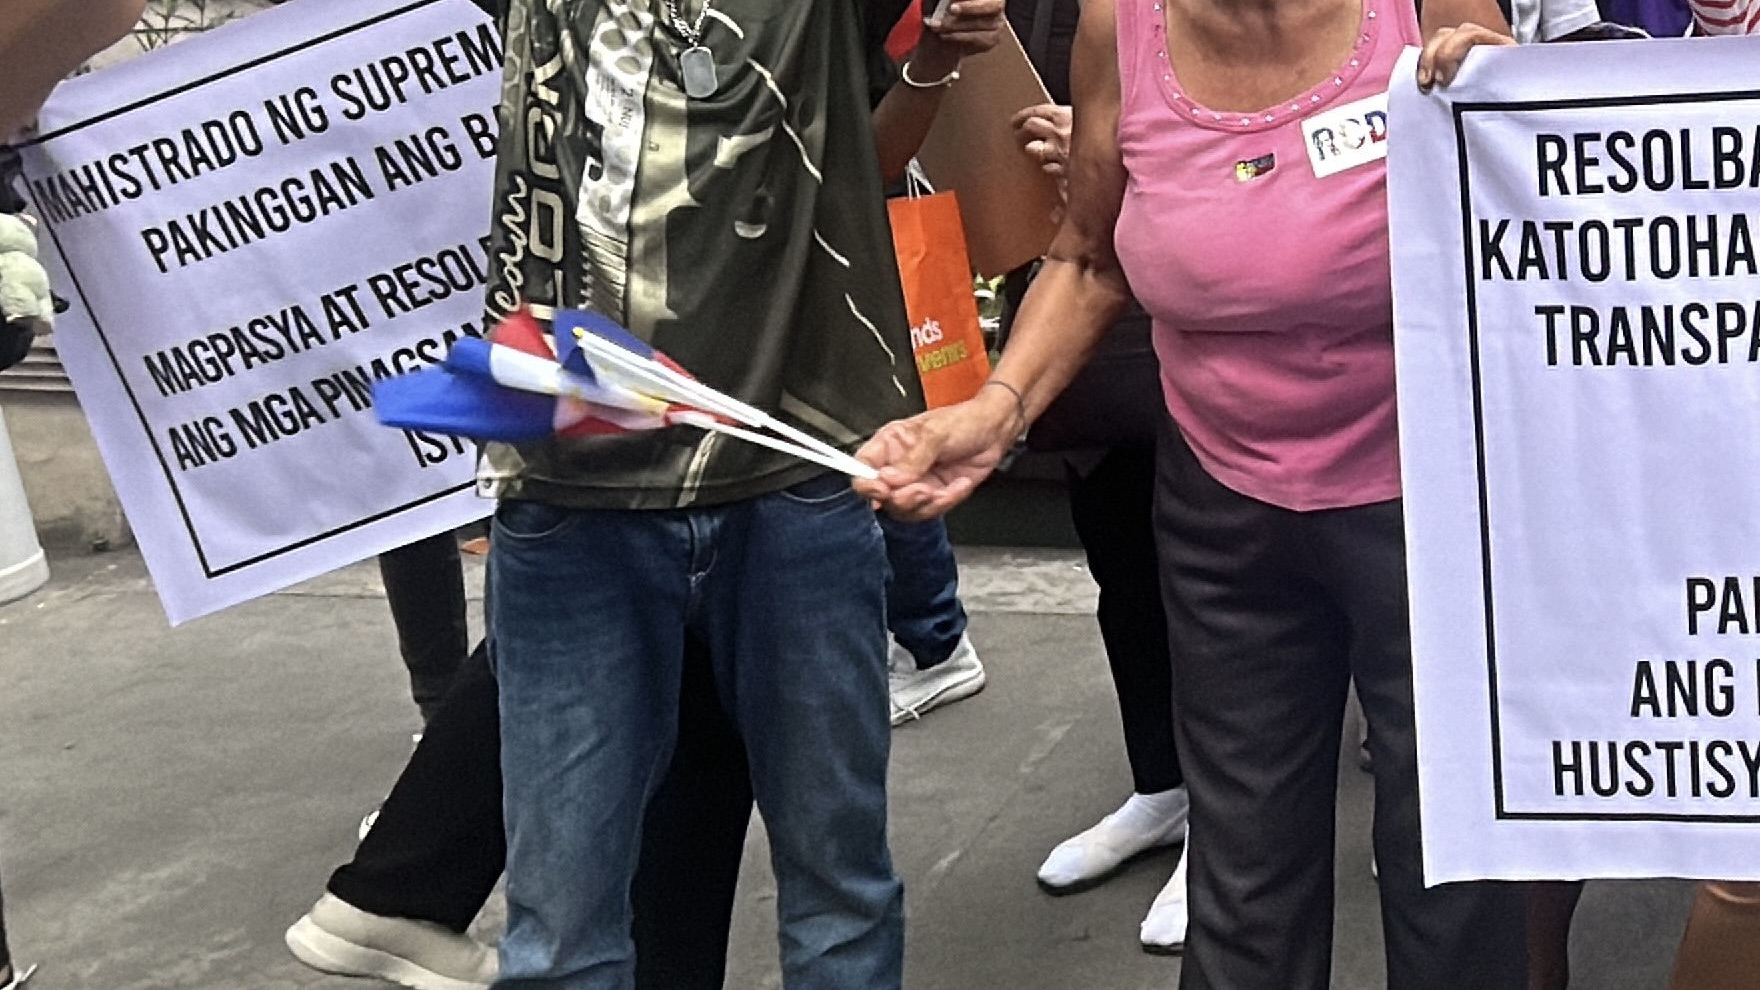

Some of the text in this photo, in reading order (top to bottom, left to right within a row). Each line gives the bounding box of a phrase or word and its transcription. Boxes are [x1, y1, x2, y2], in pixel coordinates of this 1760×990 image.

[34, 110, 265, 224] MAHISTRADO
[265, 87, 329, 145] NG
[141, 156, 375, 274] PAKINGGAN
[375, 127, 463, 192] ANG
[143, 235, 491, 398] MAGPASYA AT RESOL
[168, 426, 238, 472] ANG
[231, 394, 326, 451] MGA
[1631, 658, 1735, 718] ANG
